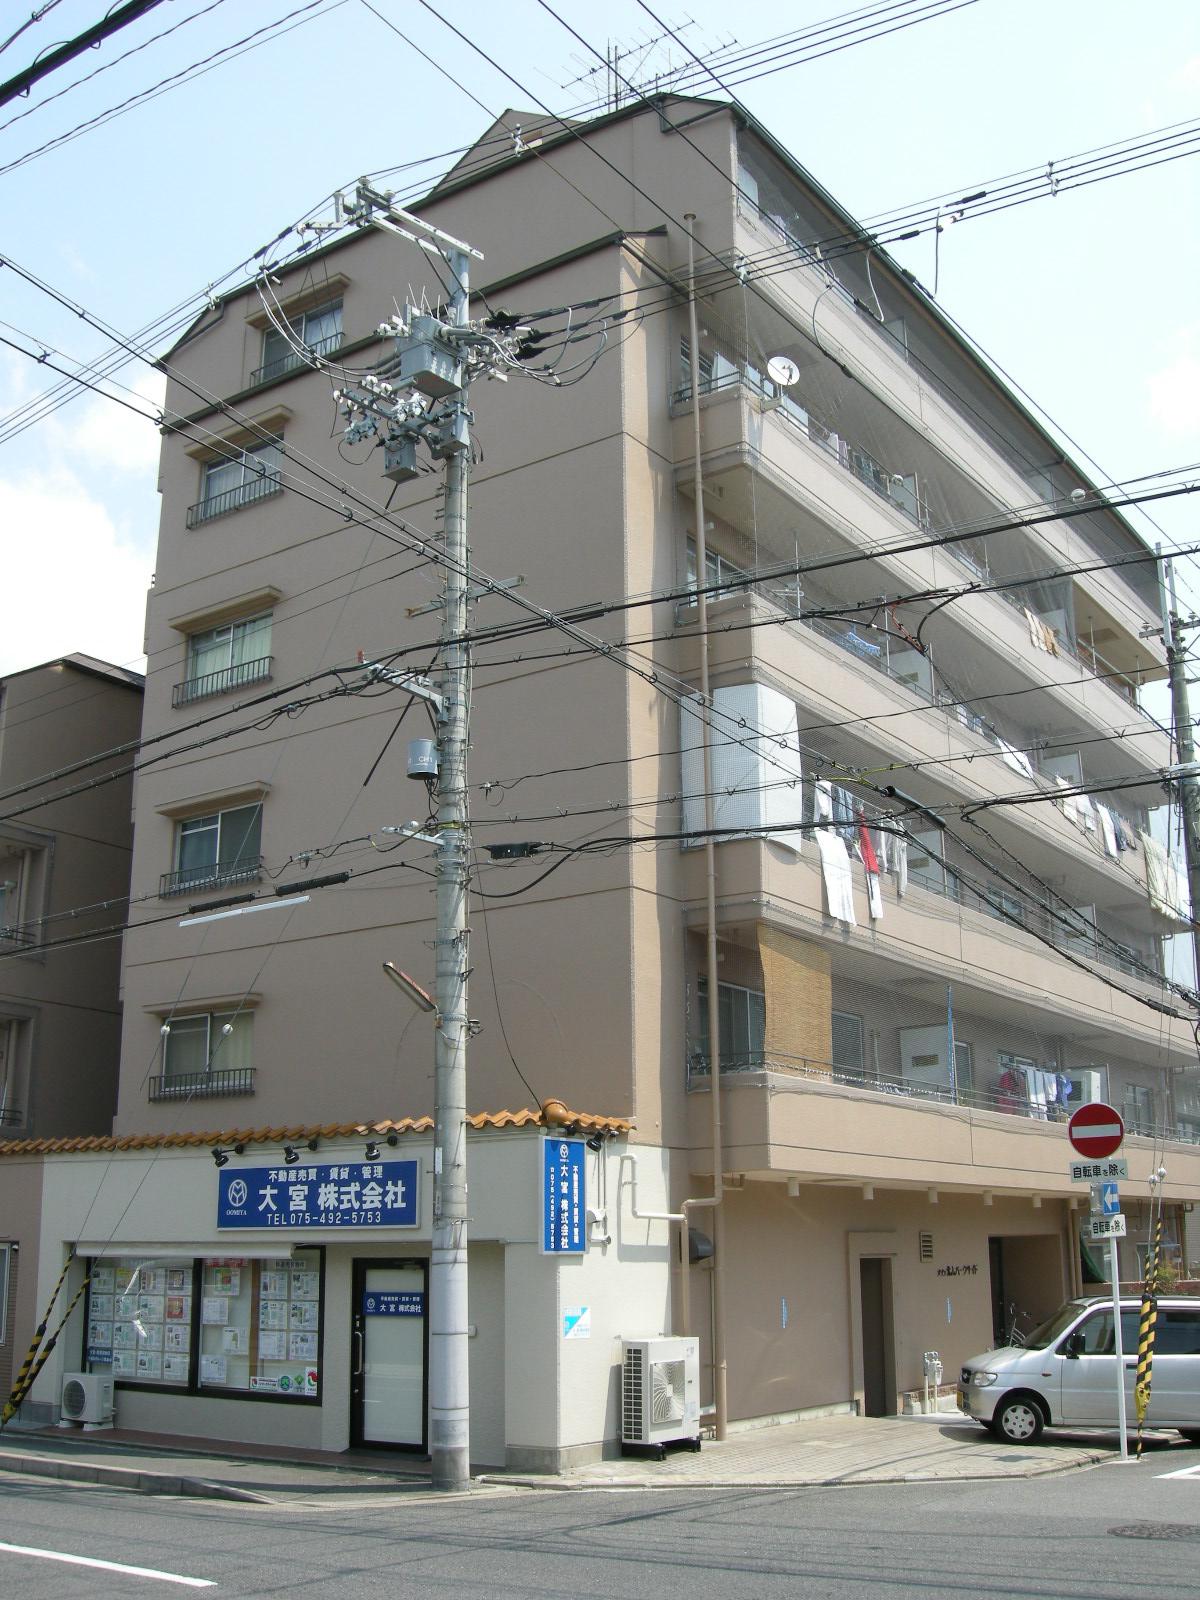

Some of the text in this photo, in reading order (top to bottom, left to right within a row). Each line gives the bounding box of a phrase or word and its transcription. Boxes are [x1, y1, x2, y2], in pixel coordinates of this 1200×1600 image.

[1073, 1163, 1125, 1179] 自転車を除く
[1092, 1219, 1125, 1234] 自転車を除く
